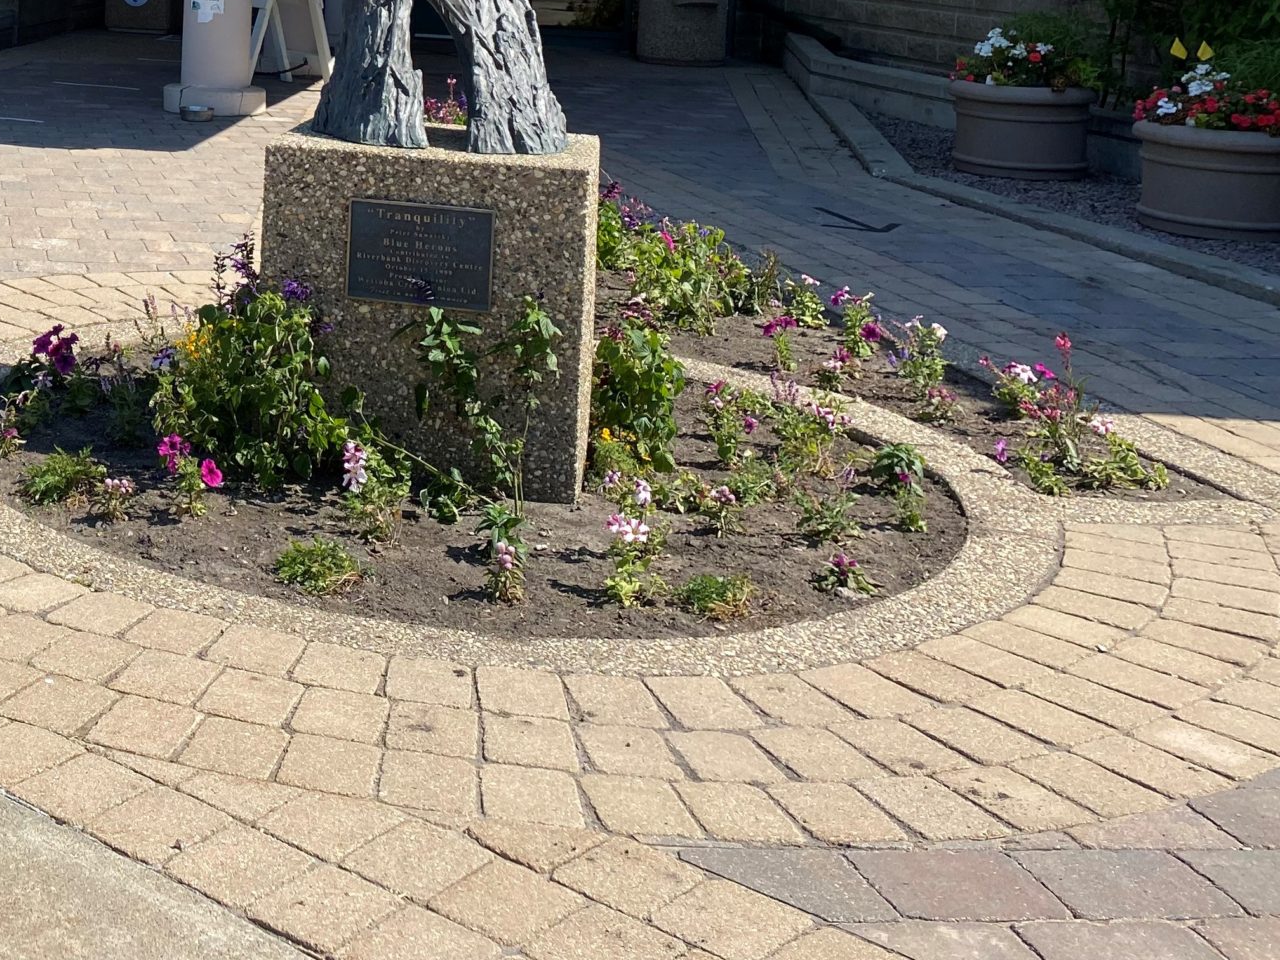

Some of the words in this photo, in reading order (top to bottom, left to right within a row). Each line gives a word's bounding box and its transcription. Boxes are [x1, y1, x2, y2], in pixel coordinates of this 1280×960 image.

[383, 238, 409, 248] Blue
[415, 241, 458, 252] Herons
[356, 251, 401, 263] Riverbank
